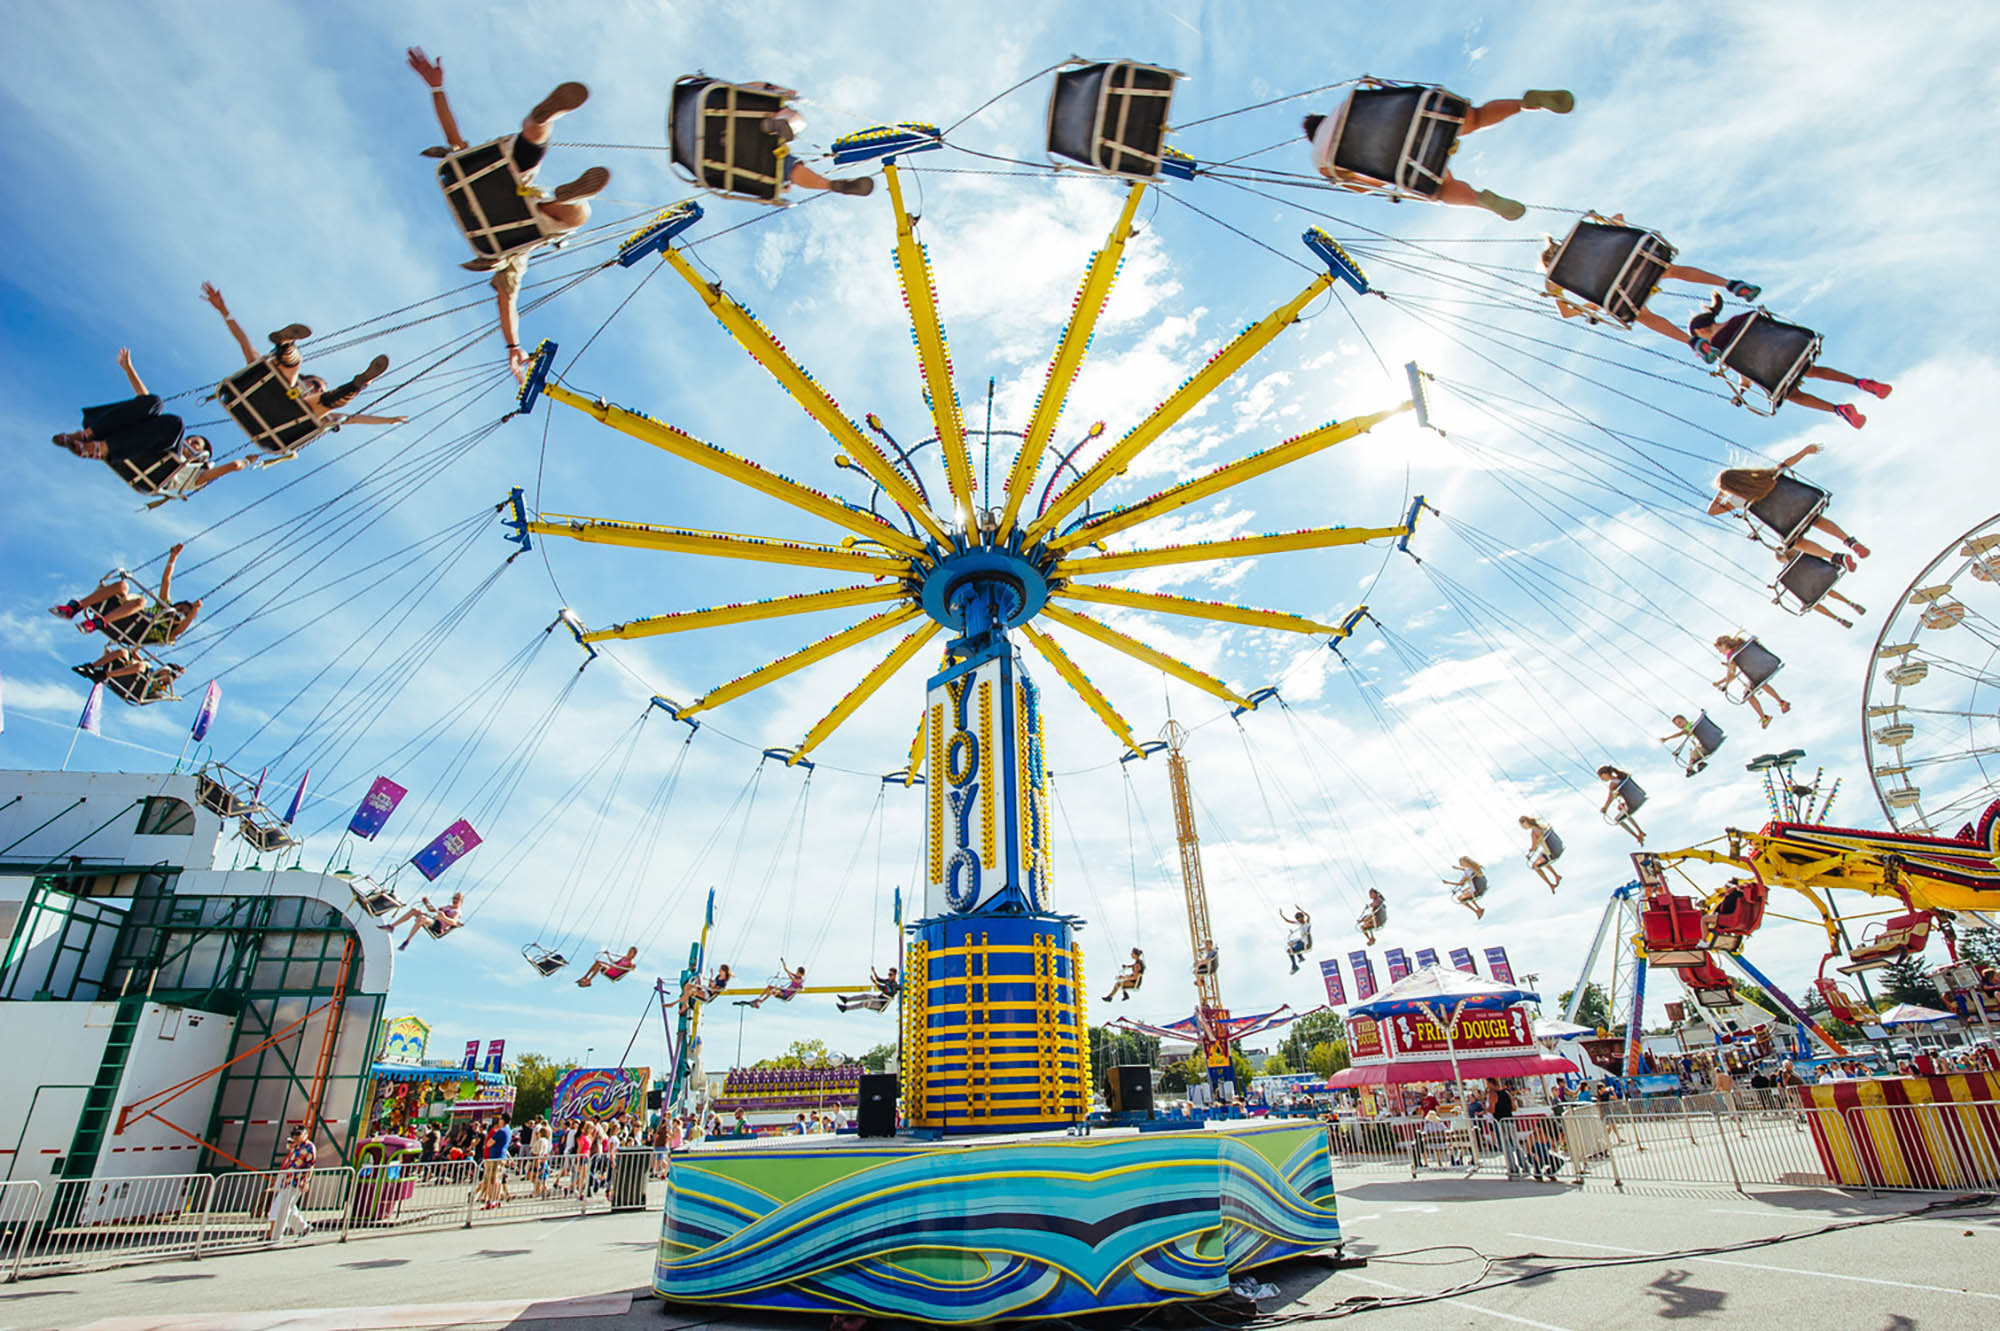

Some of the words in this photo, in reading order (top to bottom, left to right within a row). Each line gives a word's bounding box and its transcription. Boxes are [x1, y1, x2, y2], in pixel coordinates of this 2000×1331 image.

[944, 671, 981, 914] YOYO
[1461, 1019, 1510, 1040] DOUGH
[555, 1093, 593, 1122] TOP
